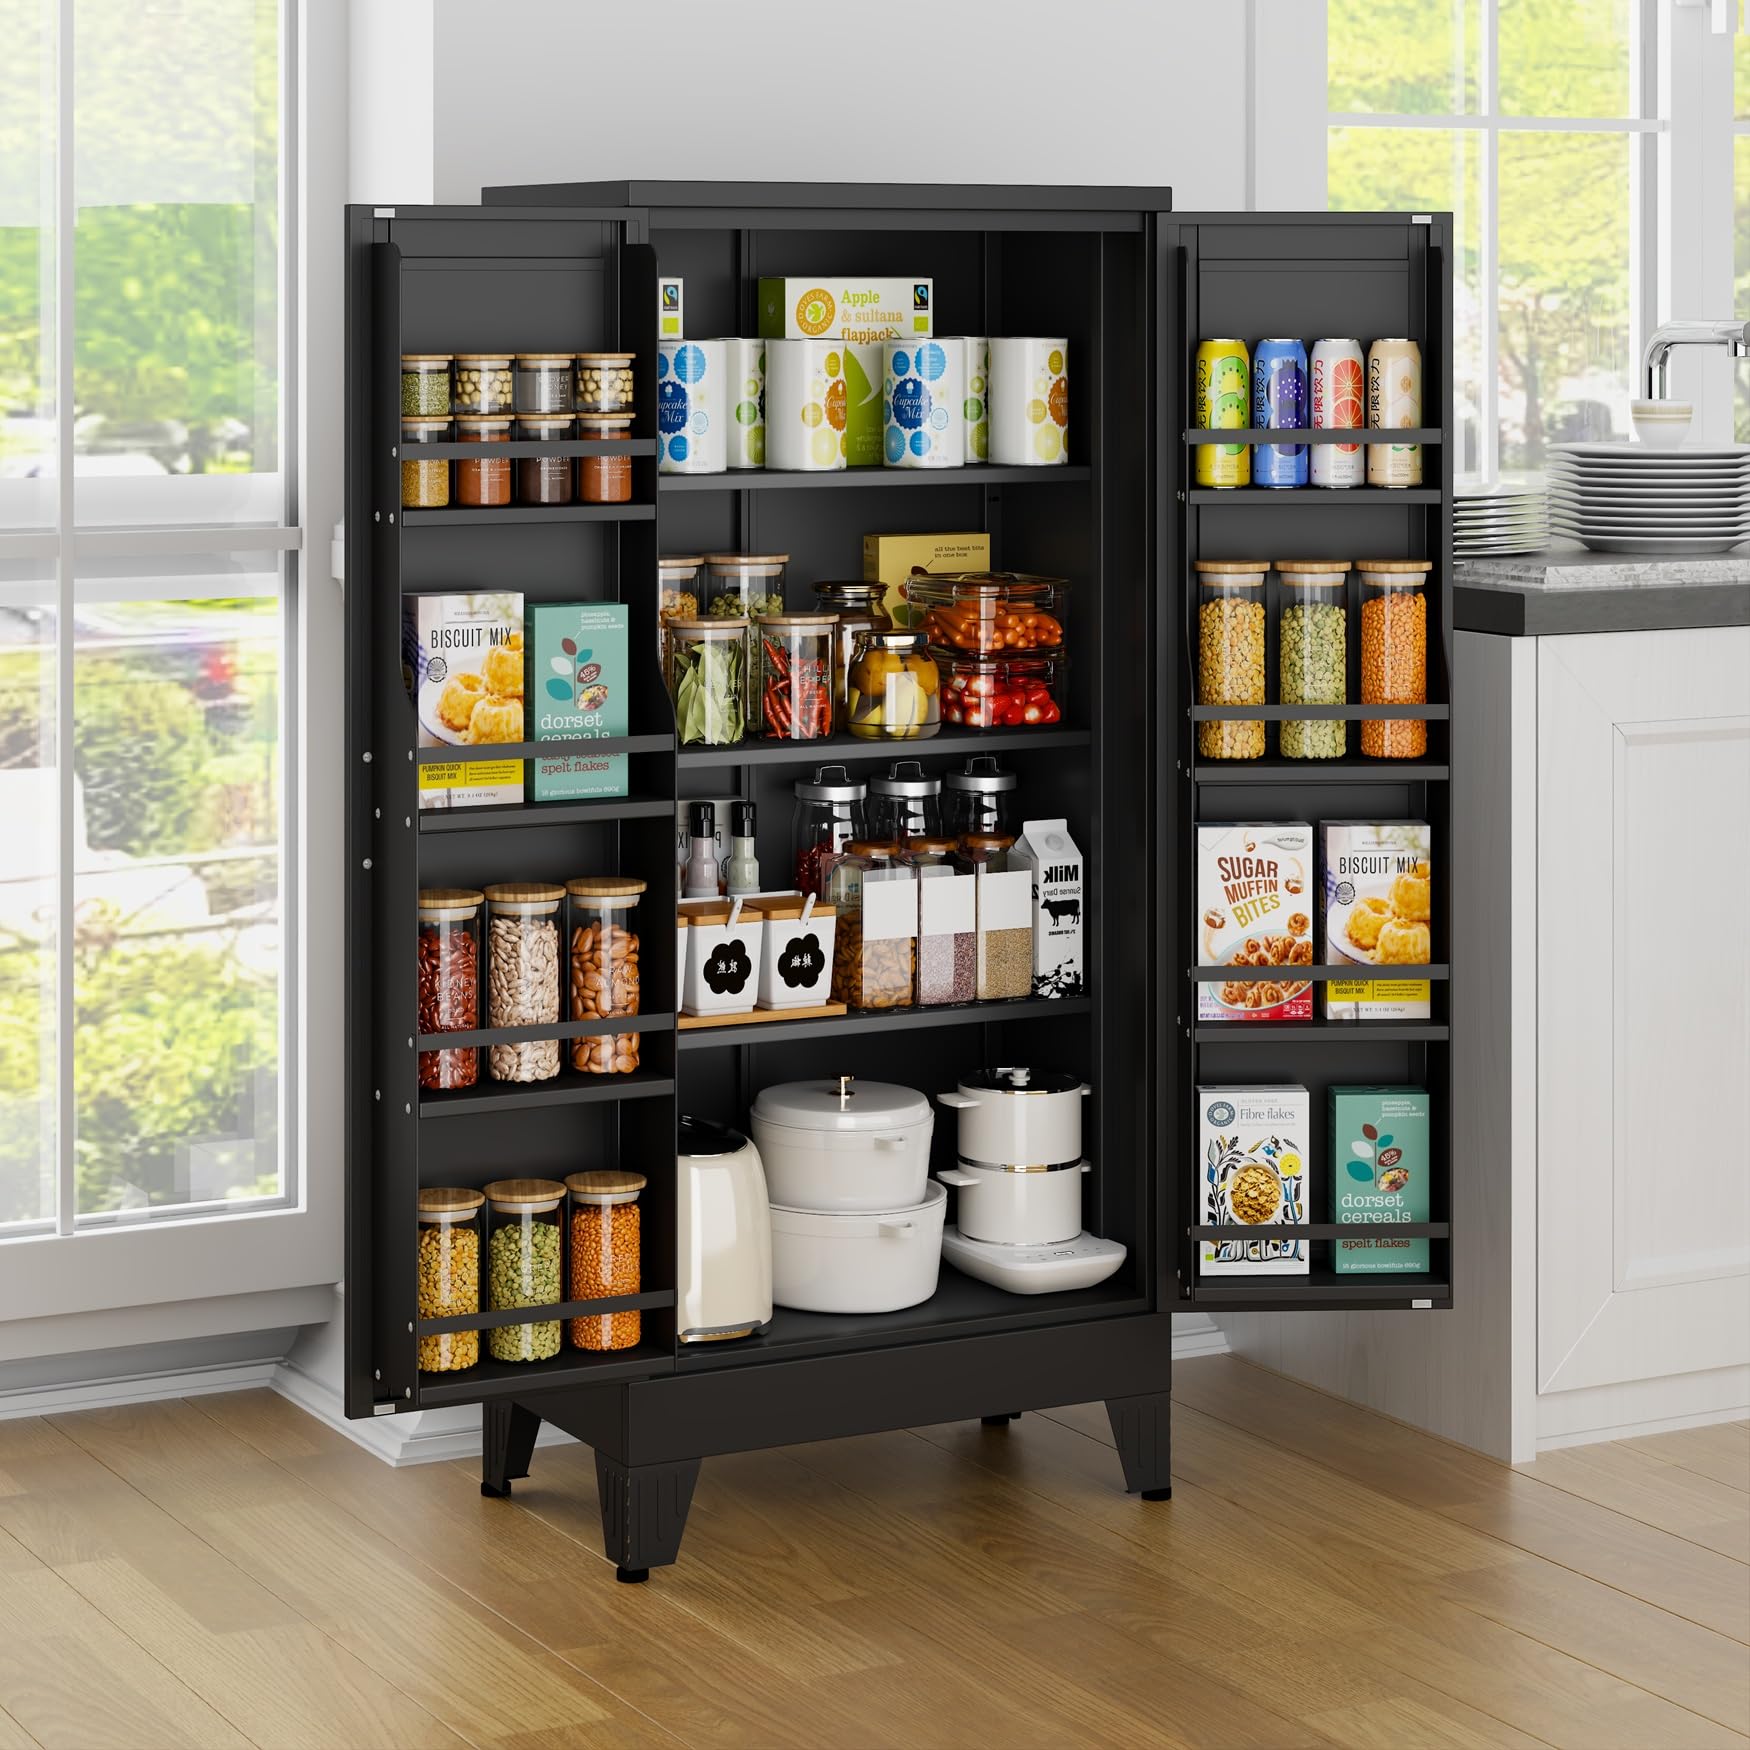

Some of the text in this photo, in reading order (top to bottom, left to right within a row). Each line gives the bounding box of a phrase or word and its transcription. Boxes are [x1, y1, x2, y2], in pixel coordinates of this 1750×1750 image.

[841, 289, 880, 307] Apple
[841, 308, 904, 323] & sultana
[841, 328, 894, 345] flapjack
[658, 399, 689, 412] upcake
[431, 627, 512, 649] BISCUIT MIX
[541, 712, 603, 730] dorset
[541, 761, 609, 775] spelt flakes
[1217, 857, 1279, 882] SUGAR
[1339, 856, 1419, 875] BISCUIT MIX
[1224, 879, 1278, 905] MUFFIN
[1231, 894, 1281, 929] BITES
[1240, 1107, 1295, 1120] Fibre flakes
[1341, 1193, 1404, 1208] dorset
[1341, 1209, 1412, 1224] cereals
[1342, 1237, 1410, 1251] spelt flakes
